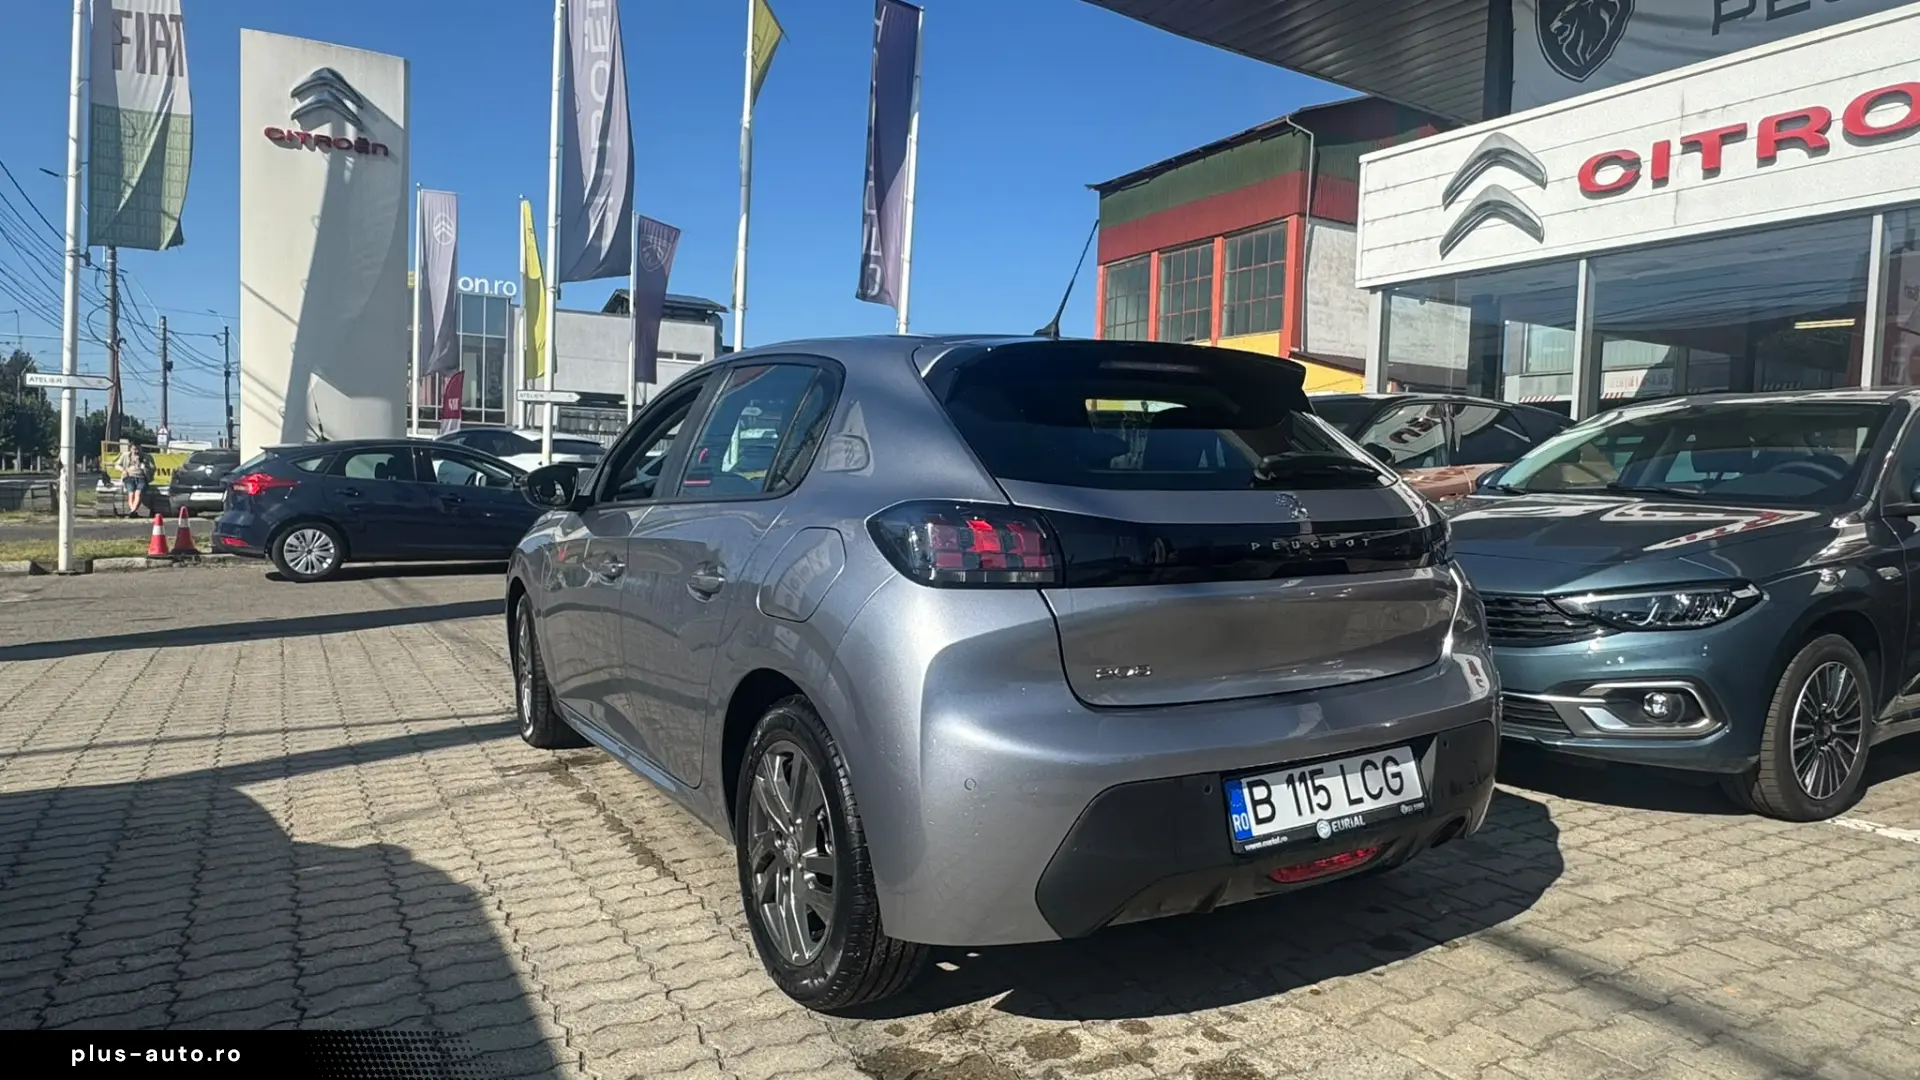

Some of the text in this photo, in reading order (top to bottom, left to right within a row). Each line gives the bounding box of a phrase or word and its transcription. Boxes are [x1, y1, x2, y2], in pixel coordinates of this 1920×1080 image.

[111, 9, 185, 77] FIAT
[1577, 82, 1920, 194] CITRO
[458, 276, 517, 296] on.ro
[1251, 538, 1370, 551] PEUGEOT
[1095, 664, 1152, 681] 208
[1247, 755, 1405, 826] B 115 LCG
[1232, 813, 1250, 833] RO
[1331, 815, 1366, 833] EURIAL
